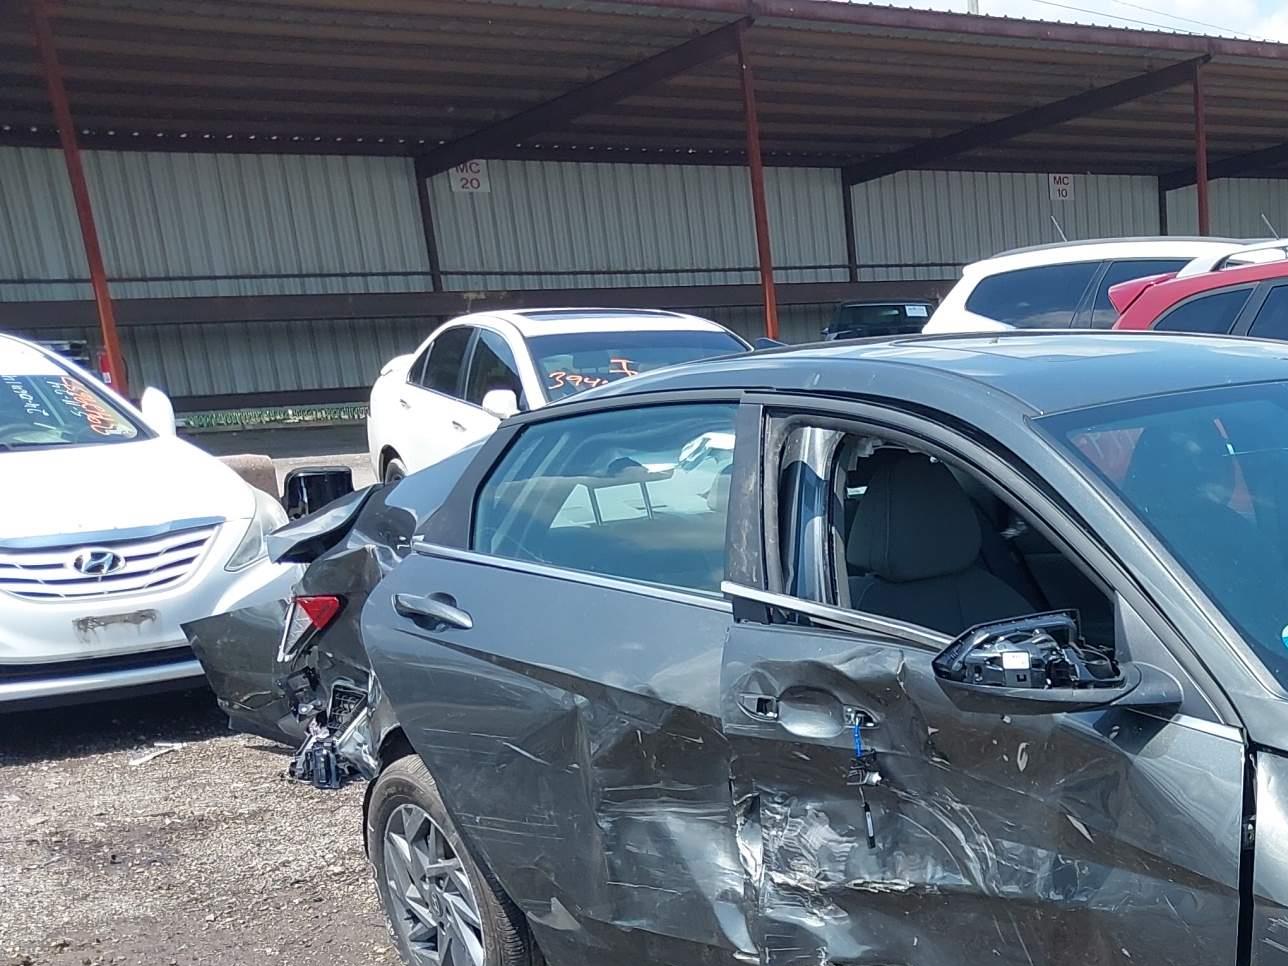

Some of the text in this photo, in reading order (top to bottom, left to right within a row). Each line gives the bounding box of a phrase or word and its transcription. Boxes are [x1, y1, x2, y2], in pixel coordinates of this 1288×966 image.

[456, 161, 481, 174] MC
[460, 177, 481, 190] 20
[1053, 175, 1070, 186] MC
[1057, 188, 1068, 198] 10
[547, 371, 609, 390] 394
